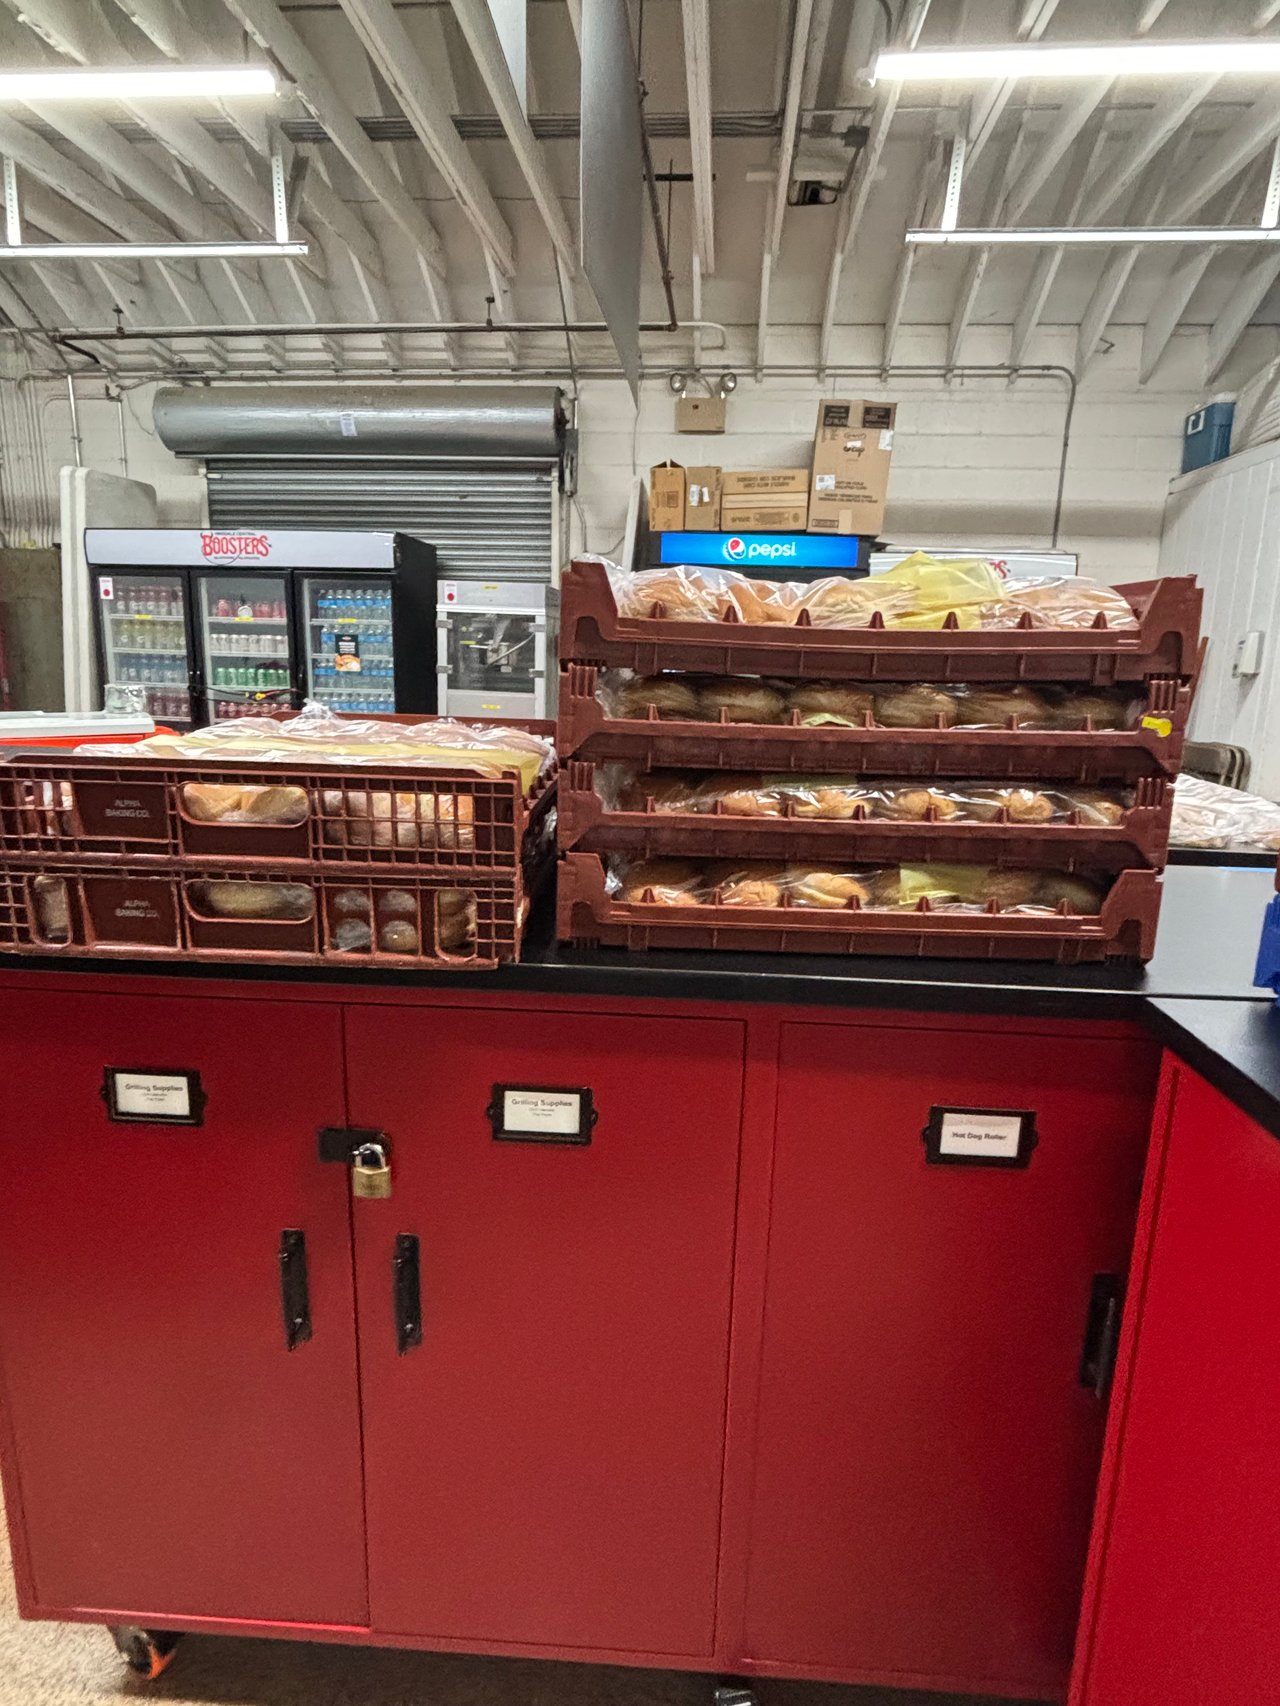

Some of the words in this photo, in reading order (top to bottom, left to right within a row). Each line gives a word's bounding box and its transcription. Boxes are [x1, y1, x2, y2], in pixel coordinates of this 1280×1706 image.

[202, 534, 269, 557] BOOSTERS
[748, 541, 797, 559] pepsi
[511, 1098, 538, 1107] Grilling
[541, 1099, 573, 1107] Supplies
[967, 1132, 983, 1141] Dog
